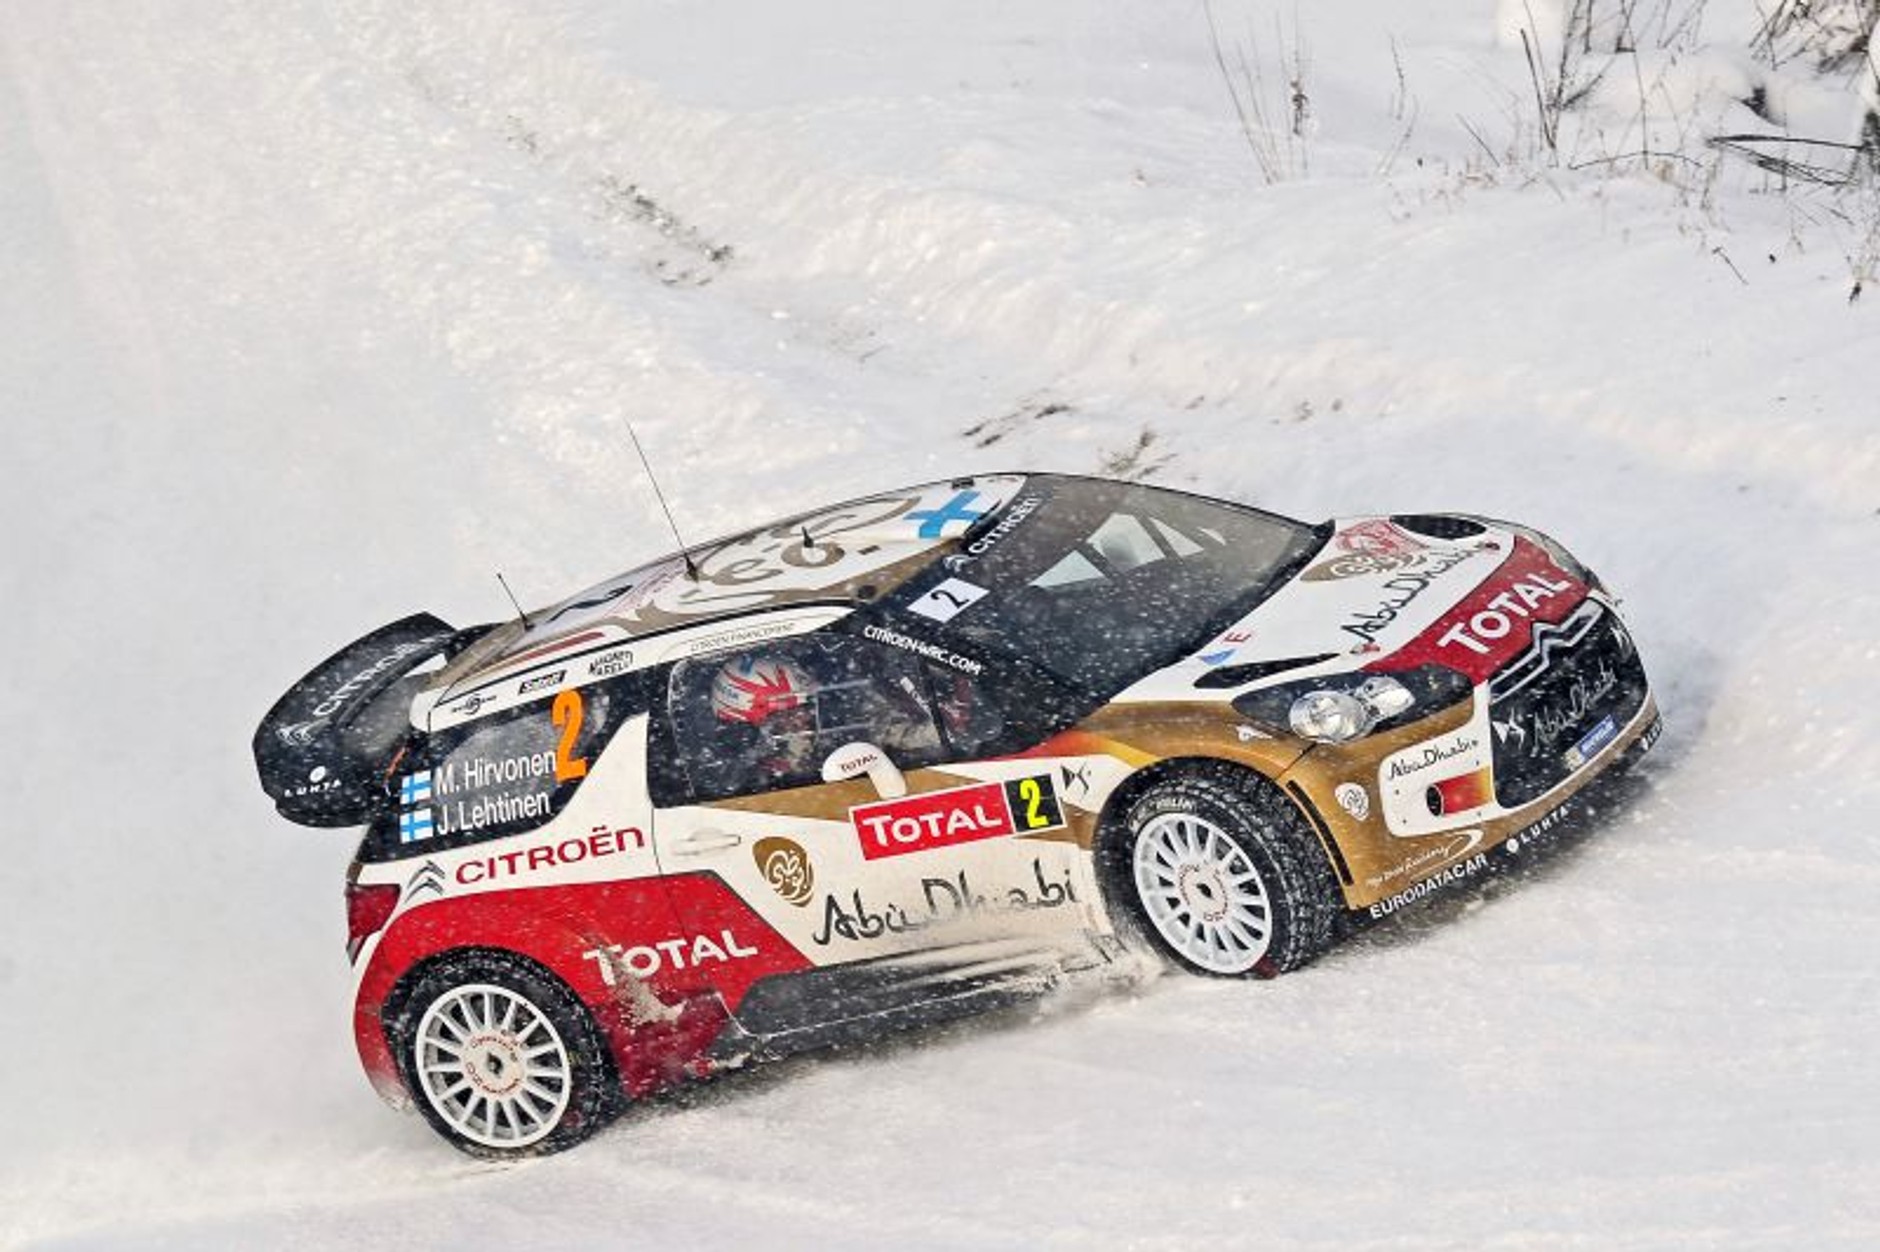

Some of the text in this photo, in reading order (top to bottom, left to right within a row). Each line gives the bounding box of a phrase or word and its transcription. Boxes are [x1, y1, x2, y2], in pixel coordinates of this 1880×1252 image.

[929, 589, 971, 609] 2
[1437, 570, 1573, 656] TOTAL
[549, 687, 587, 785] 2
[838, 751, 880, 773] TOTAL
[434, 749, 556, 796] M. Hirvonen
[437, 788, 550, 834] J. Lehtinen
[861, 795, 1003, 848] TOTAL
[1019, 778, 1048, 829] 2
[1369, 853, 1489, 920] EURODATACAR
[812, 888, 920, 946] Abu
[582, 929, 758, 987] TOTAL
